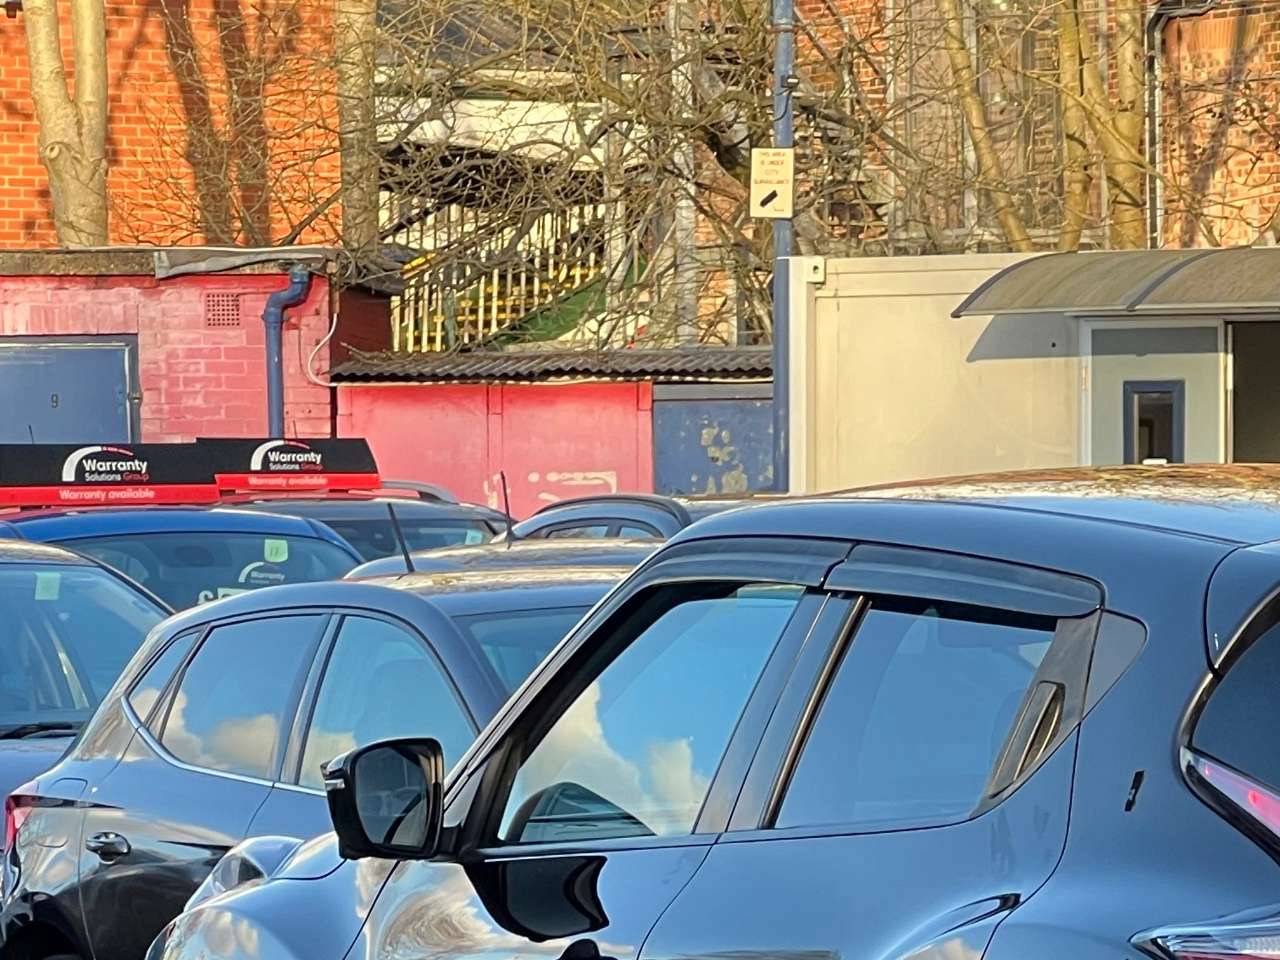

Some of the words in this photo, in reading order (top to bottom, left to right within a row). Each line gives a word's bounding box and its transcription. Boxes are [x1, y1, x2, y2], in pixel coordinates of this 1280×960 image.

[51, 393, 58, 408] 9
[268, 450, 322, 464] Warranty
[83, 458, 147, 473] Warranty
[85, 472, 121, 482] Solutions
[123, 473, 149, 483] Group
[248, 477, 286, 487] Warranty
[288, 476, 328, 486] available
[59, 489, 106, 501] Warranty
[108, 488, 155, 498] available
